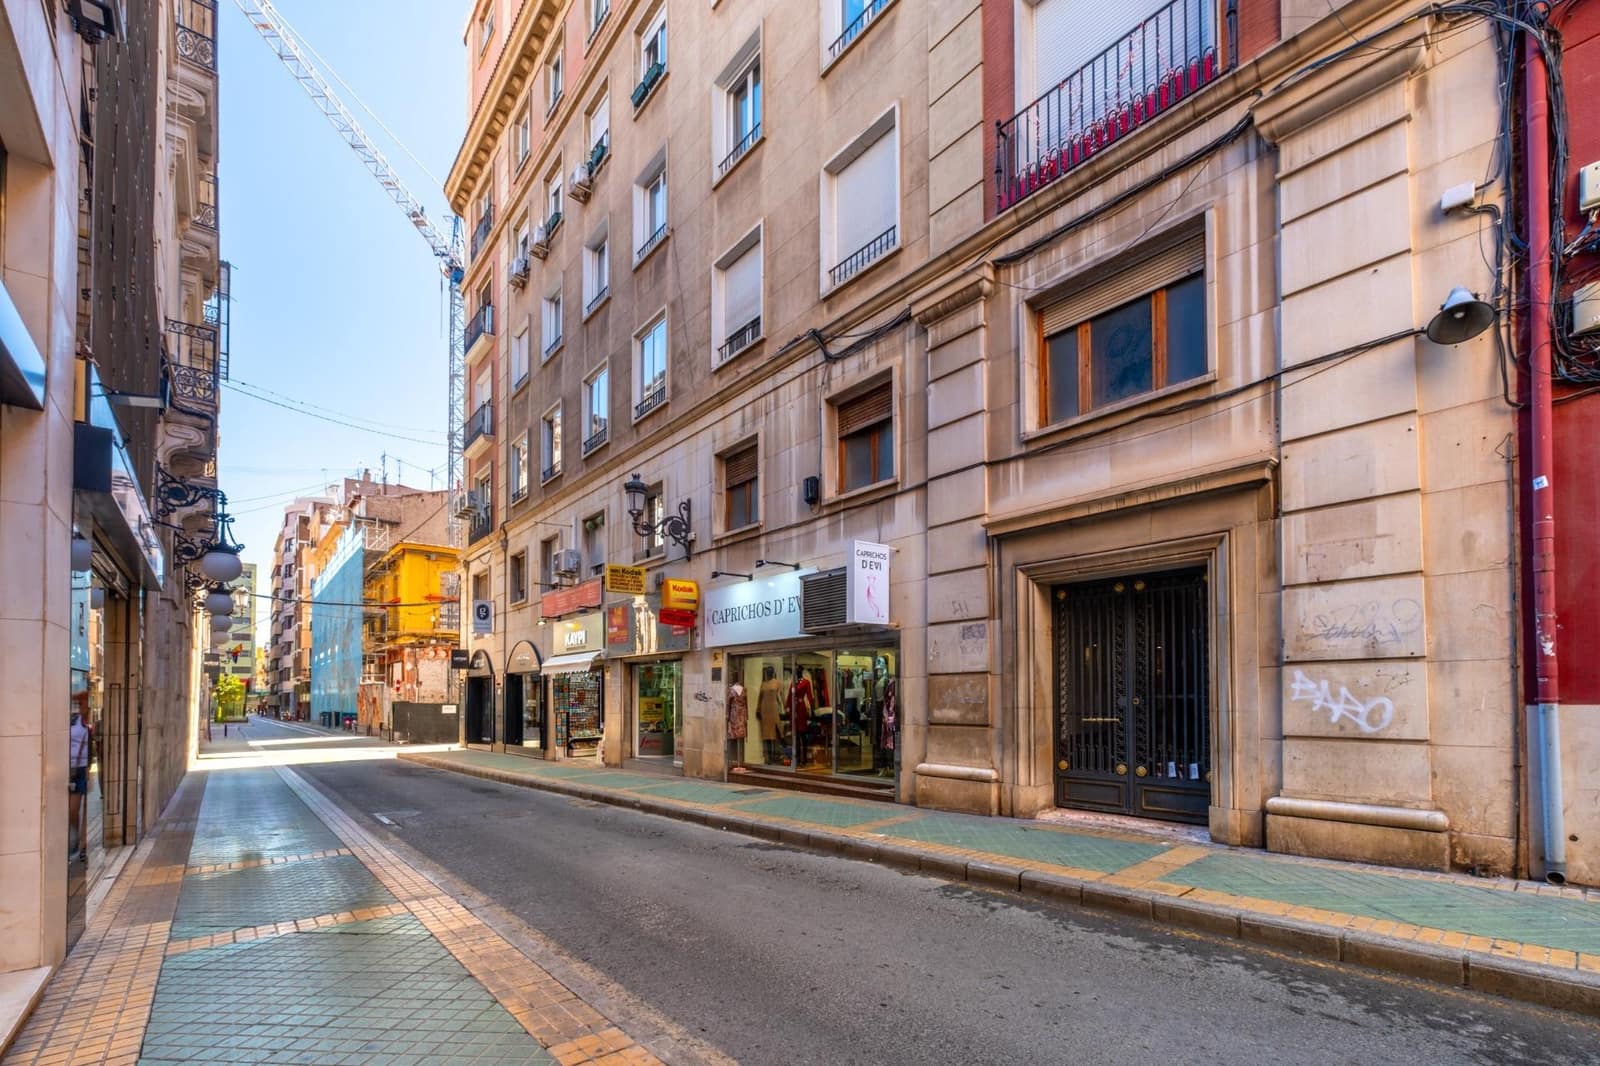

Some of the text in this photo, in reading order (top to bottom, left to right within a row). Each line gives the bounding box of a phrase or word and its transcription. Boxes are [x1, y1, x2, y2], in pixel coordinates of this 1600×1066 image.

[856, 549, 887, 561] CAPRICHOS
[621, 567, 642, 576] Kodak
[672, 584, 694, 593] Kodak
[712, 600, 771, 626] CAPRICHOS
[788, 596, 802, 613] EV
[565, 630, 586, 646] KAYPI
